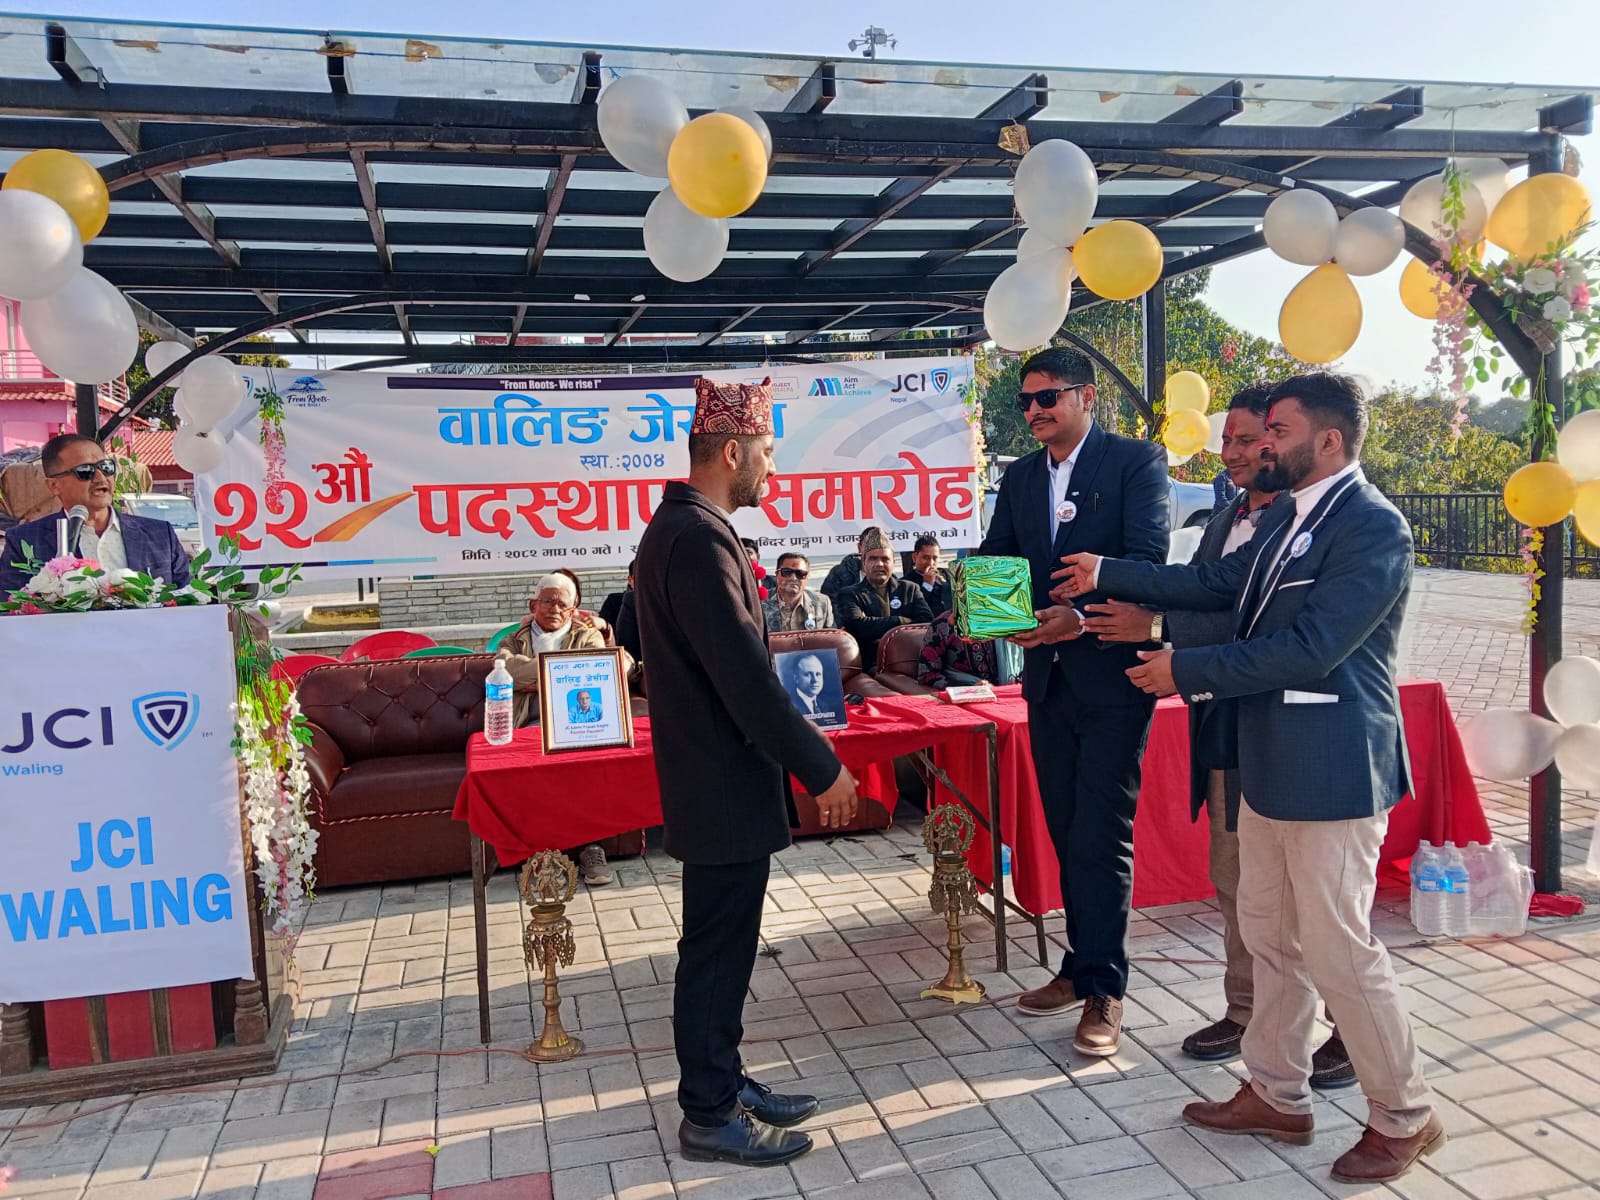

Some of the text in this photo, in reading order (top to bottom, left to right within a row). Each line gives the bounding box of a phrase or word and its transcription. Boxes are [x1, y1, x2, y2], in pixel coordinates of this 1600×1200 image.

[559, 380, 574, 389] We
[891, 373, 926, 392] JCI
[438, 393, 609, 447] वालिङ
[760, 452, 976, 528] समारोह
[462, 549, 491, 561] मिति
[1, 707, 113, 753] JCI
[2, 763, 63, 776] Waling
[71, 816, 154, 872] JCI
[0, 873, 233, 942] WALING
